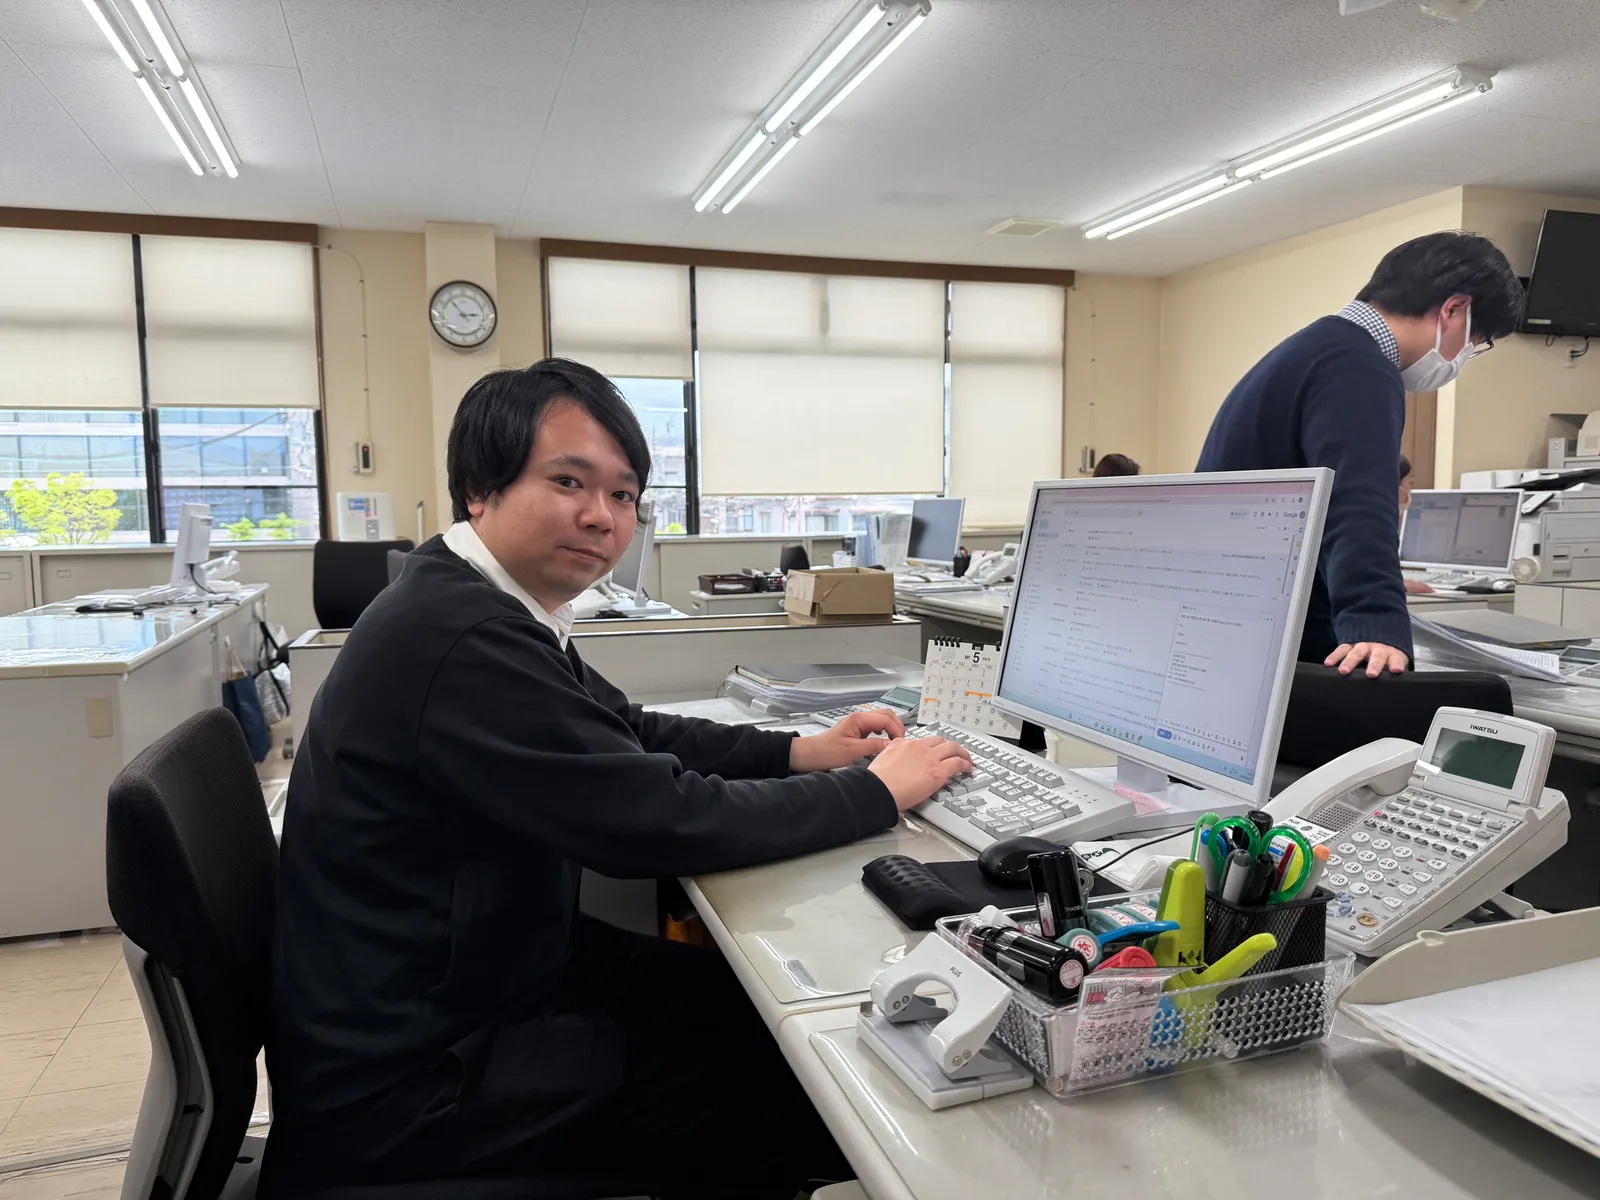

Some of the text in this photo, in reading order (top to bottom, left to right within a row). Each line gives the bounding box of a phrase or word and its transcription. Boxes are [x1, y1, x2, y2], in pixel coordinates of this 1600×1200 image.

[973, 652, 980, 663] 5
[1470, 724, 1498, 734] IWATSU
[950, 966, 962, 978] PLUS
